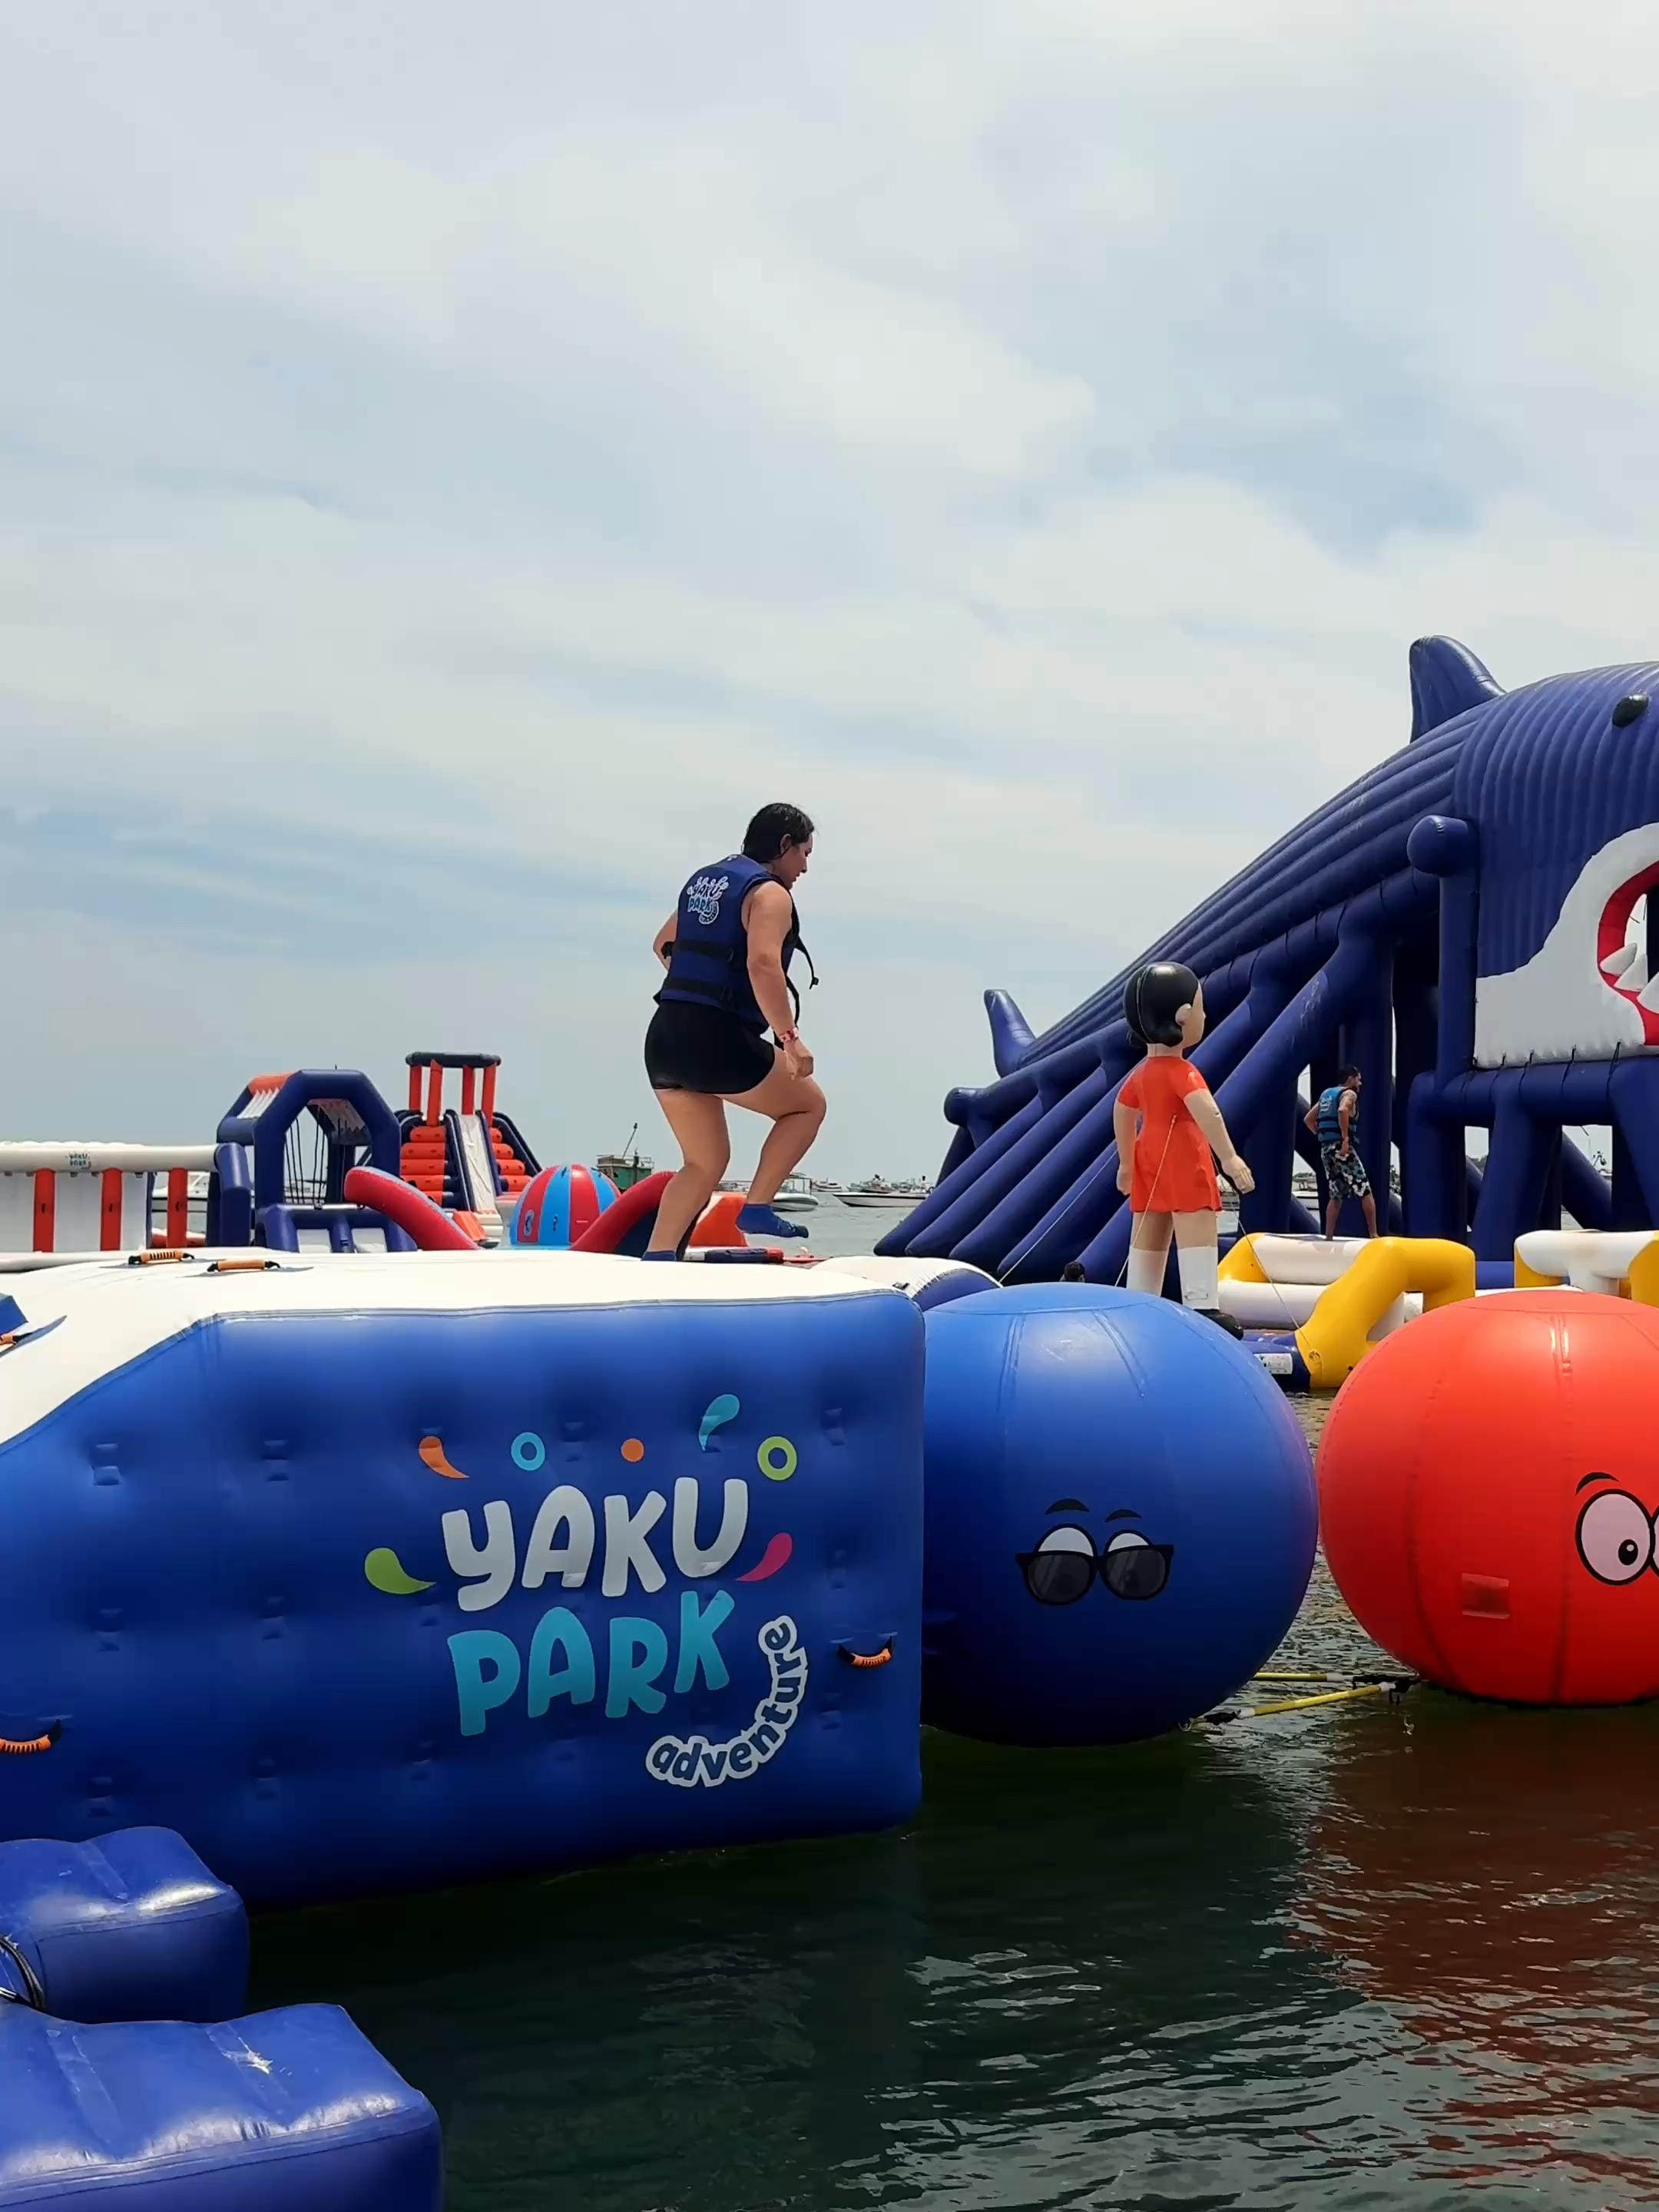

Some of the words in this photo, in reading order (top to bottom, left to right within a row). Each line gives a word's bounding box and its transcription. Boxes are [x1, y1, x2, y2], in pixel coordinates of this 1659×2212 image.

[442, 1477, 747, 1611] YAKU
[446, 1589, 734, 1735] PARK
[651, 1621, 803, 1782] adventure
